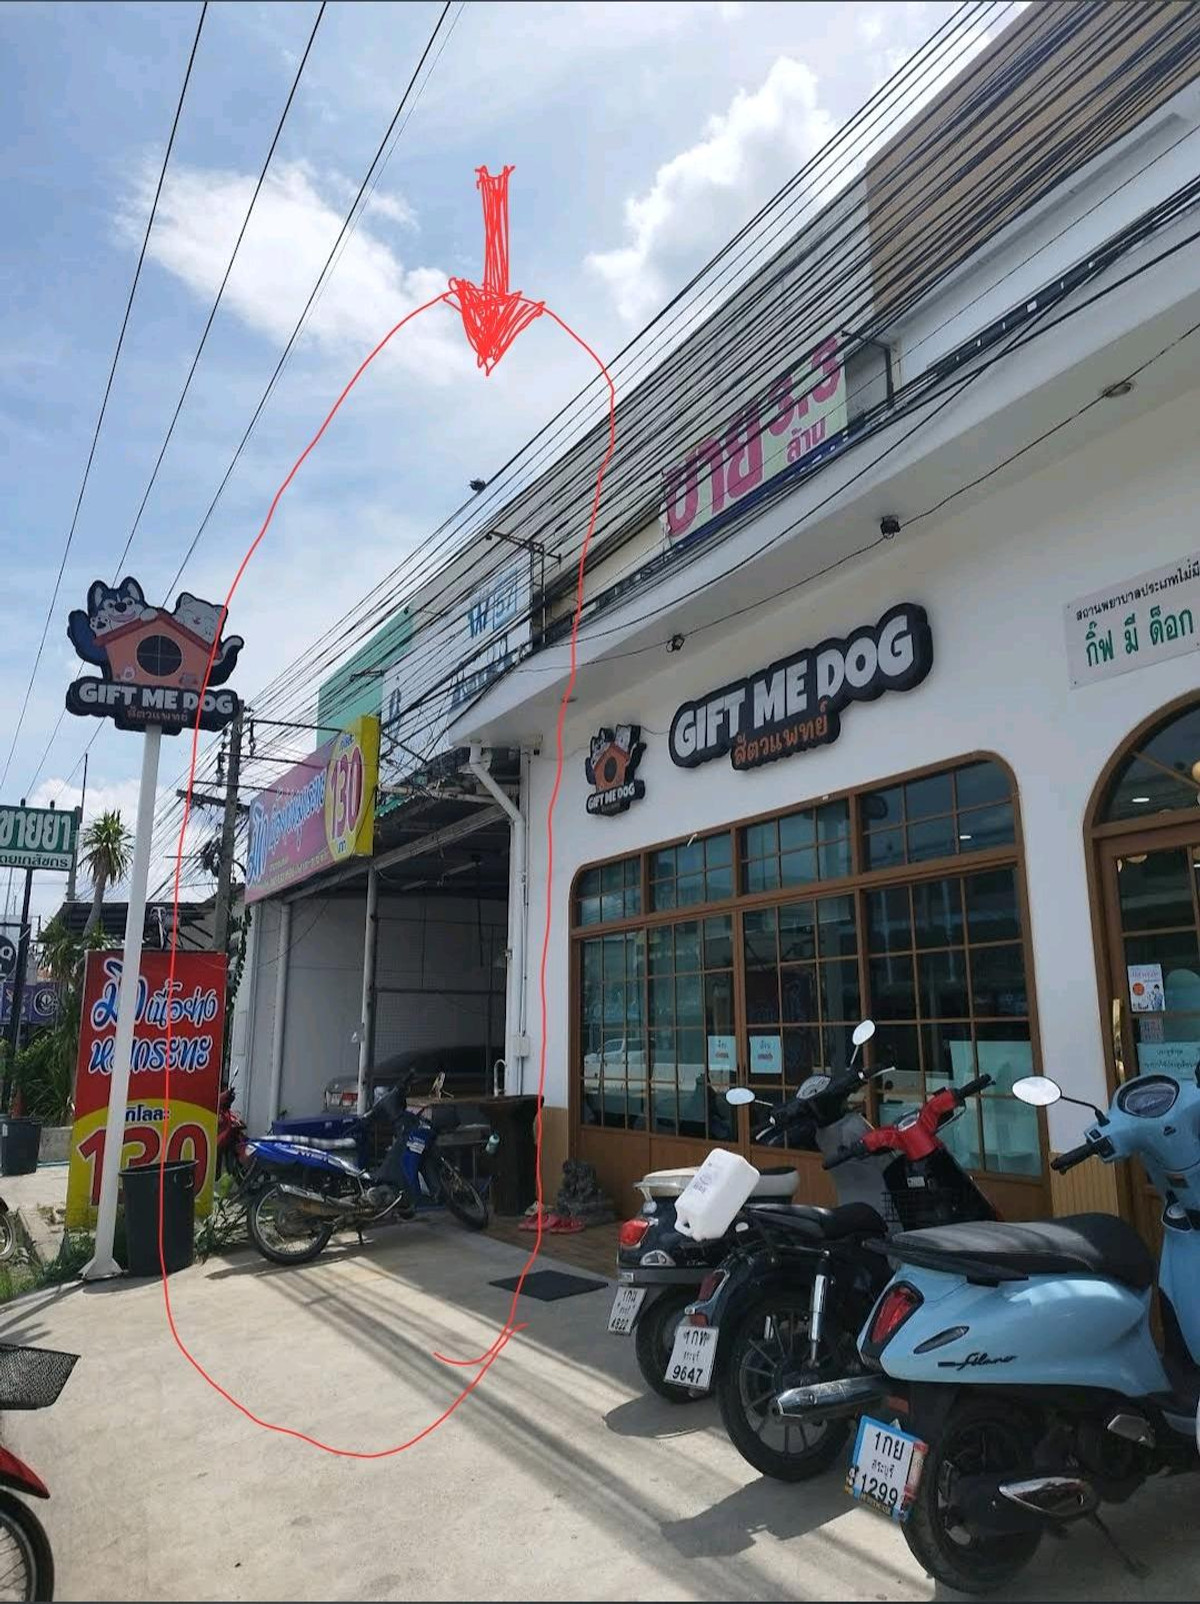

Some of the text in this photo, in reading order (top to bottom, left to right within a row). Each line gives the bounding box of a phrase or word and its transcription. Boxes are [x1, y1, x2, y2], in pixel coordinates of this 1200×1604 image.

[787, 417, 826, 464] ล้าน
[665, 404, 763, 537] ขาย
[1124, 613, 1139, 655] มี
[1150, 605, 1194, 646] ด็อก
[79, 682, 234, 714] GIFT ME DOG
[674, 615, 914, 757] GIFT ME DOG
[734, 701, 829, 765] สัตวแพทย์
[588, 794, 605, 810] GIFT
[605, 789, 617, 804] ME
[617, 782, 636, 799] DOG
[0, 809, 71, 851] ขายยา
[672, 1365, 704, 1384] 9647
[875, 1431, 905, 1461] 1กย
[861, 1473, 899, 1510] 1299
